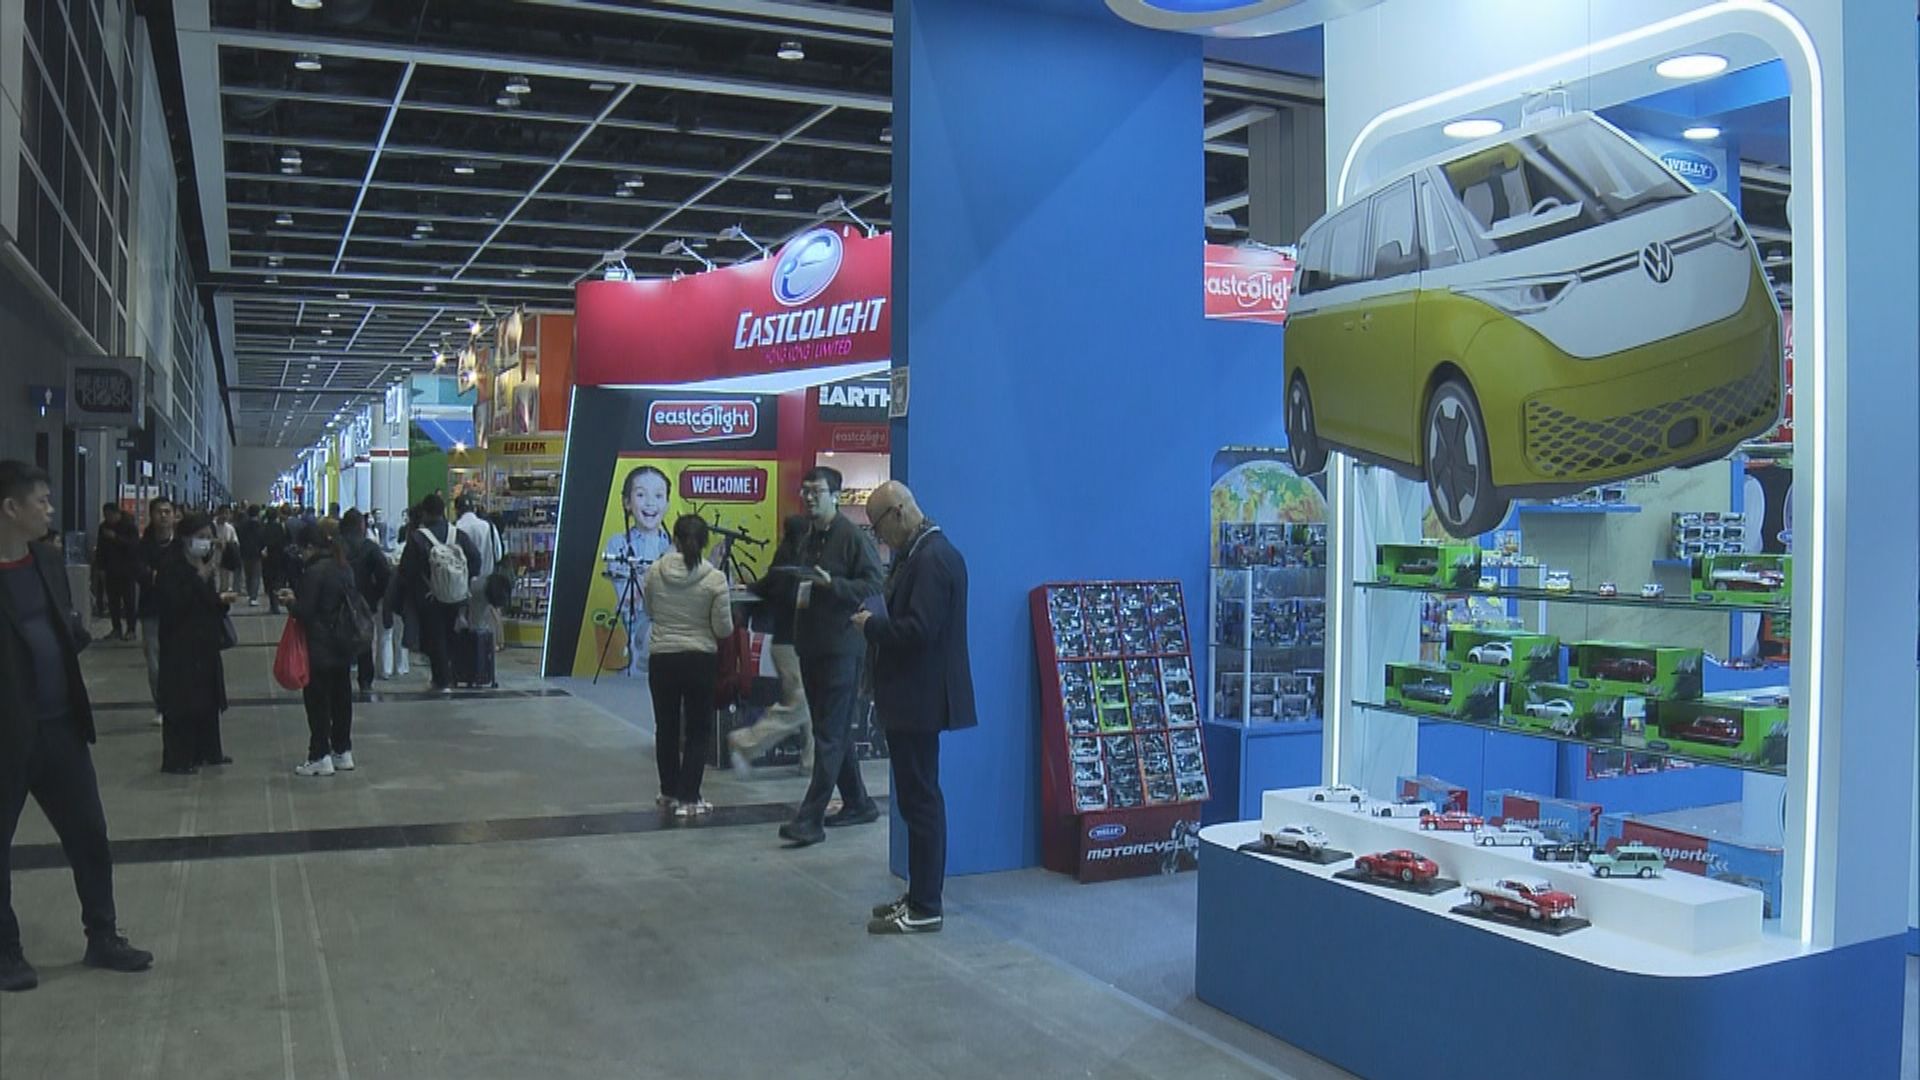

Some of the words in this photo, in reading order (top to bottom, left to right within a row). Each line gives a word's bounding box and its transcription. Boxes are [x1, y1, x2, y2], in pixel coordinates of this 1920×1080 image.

[1667, 158, 1708, 176] WELLY
[1207, 273, 1290, 310] astcoligh
[734, 298, 887, 350] EASTCOLIGHT
[815, 338, 852, 358] LIMITED
[654, 406, 750, 433] eastcolight
[691, 475, 751, 494] WELCOME
[1087, 840, 1188, 860] MOTORCYCL
[1658, 847, 1718, 864] sporter
